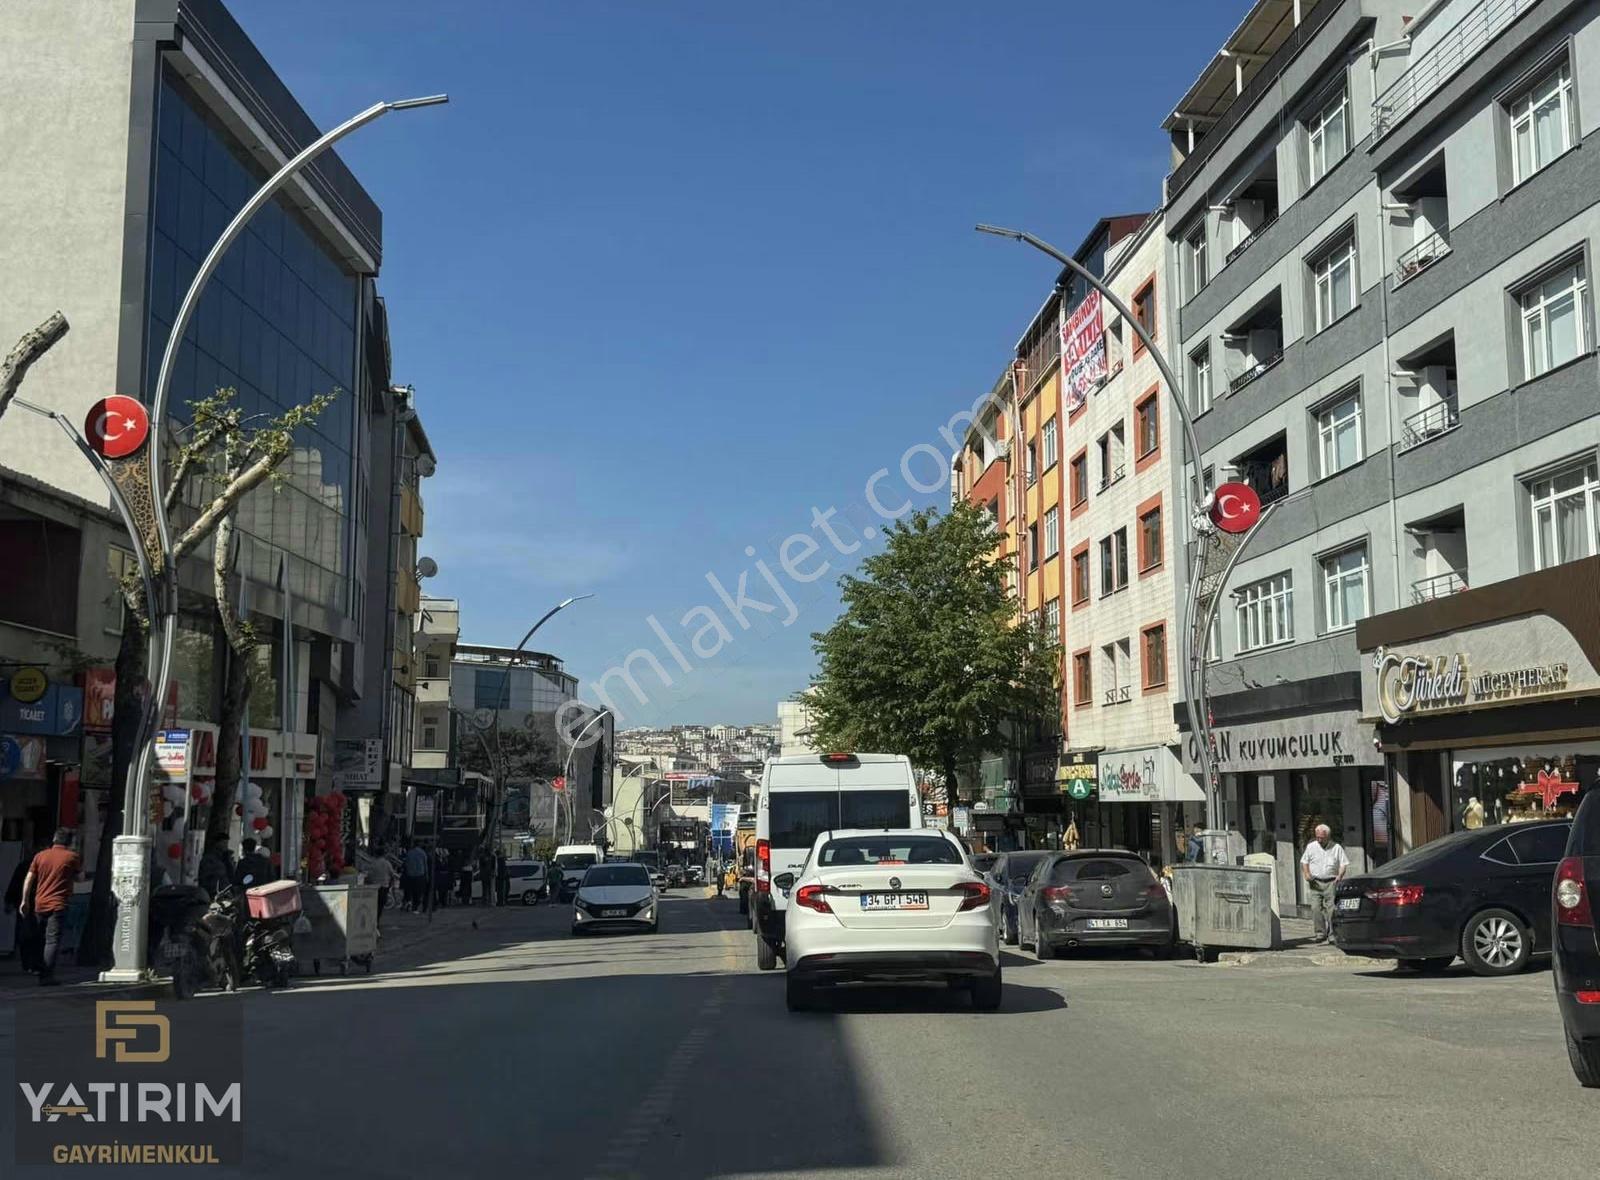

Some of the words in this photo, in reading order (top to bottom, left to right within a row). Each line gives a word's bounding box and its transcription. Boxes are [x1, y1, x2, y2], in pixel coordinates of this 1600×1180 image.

[1395, 652, 1464, 711] Türkeli
[868, 894, 880, 906] 34
[884, 892, 903, 906] GPT
[906, 893, 925, 905] 548
